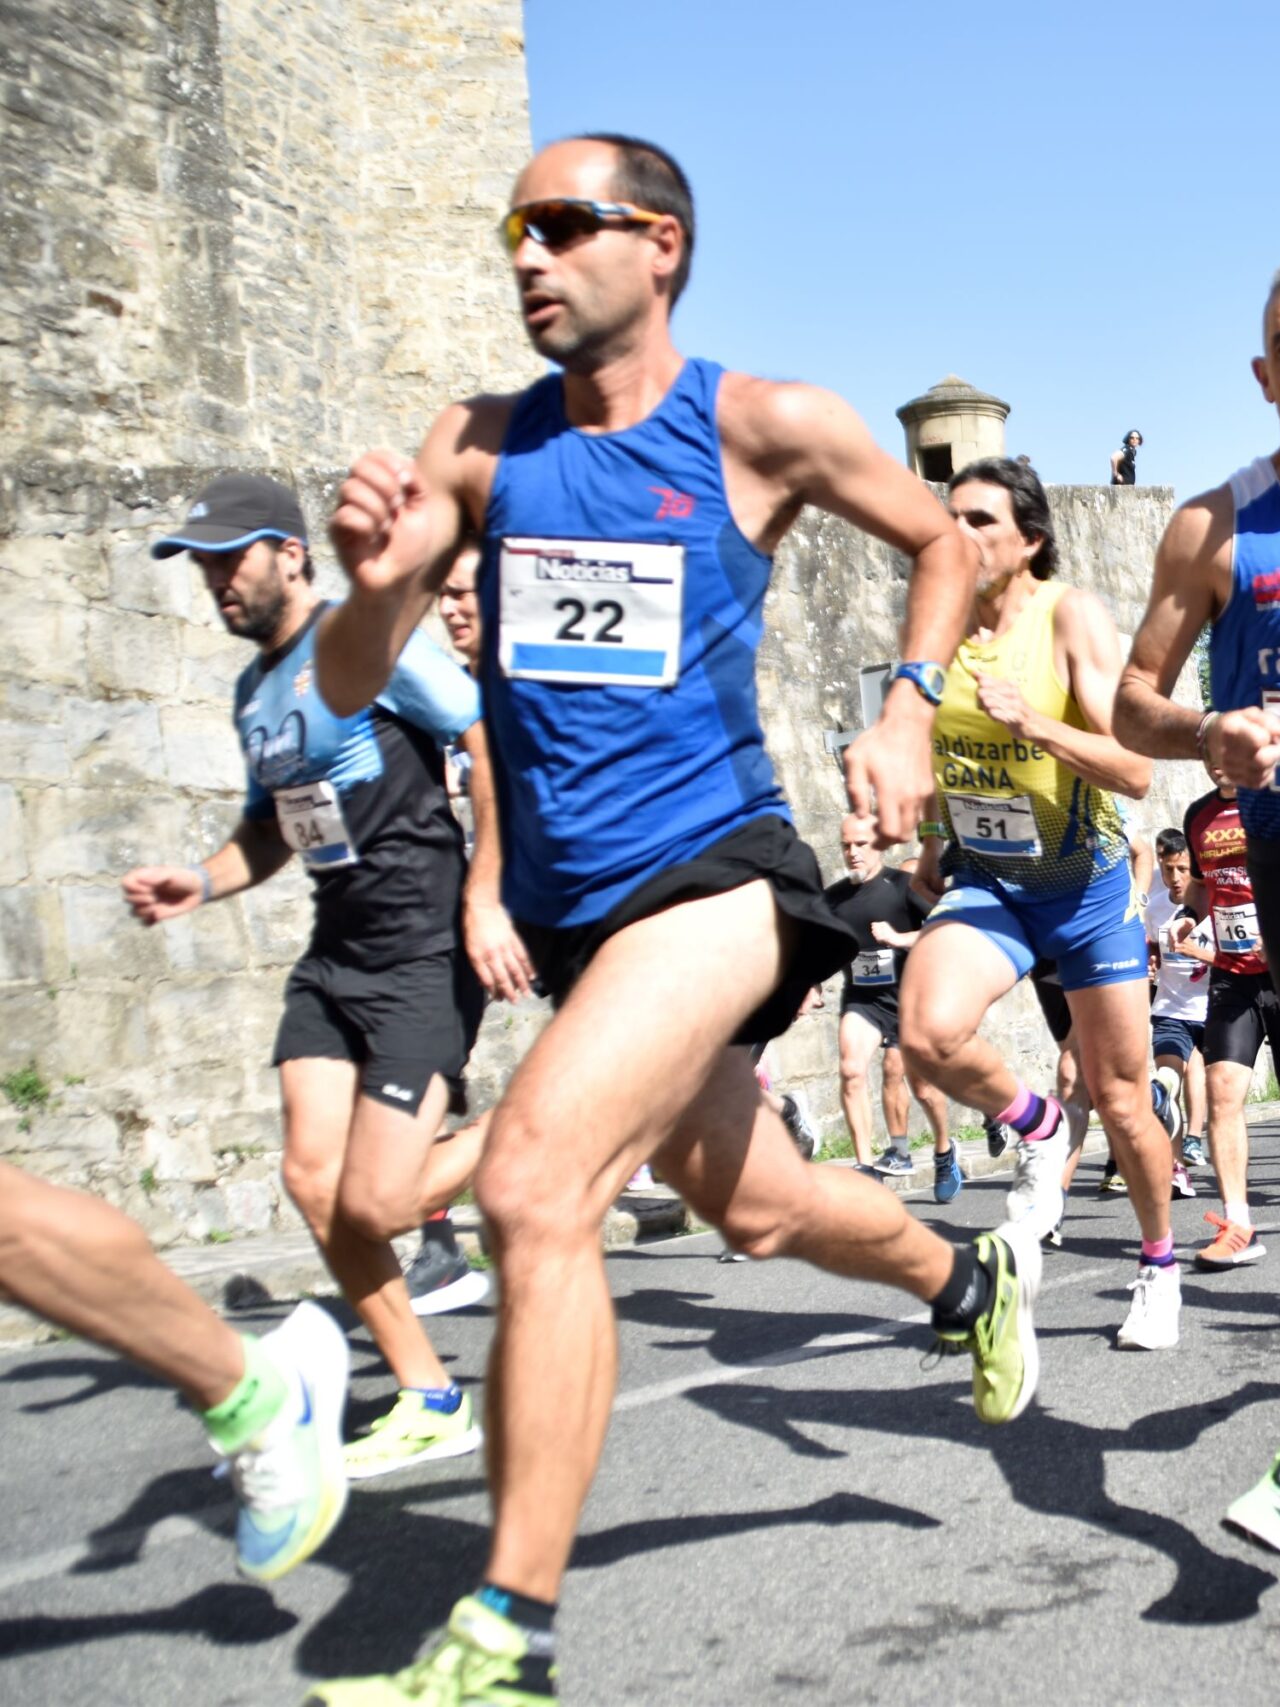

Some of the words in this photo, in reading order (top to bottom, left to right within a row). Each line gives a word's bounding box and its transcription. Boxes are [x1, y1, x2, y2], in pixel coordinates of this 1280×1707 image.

[538, 557, 630, 582] Noticias
[554, 597, 624, 643] 22
[934, 735, 1045, 763] aldizarbe
[943, 763, 1015, 791] GANA
[976, 817, 1008, 840] 51
[1225, 925, 1247, 940] 16
[862, 964, 881, 976] 34
